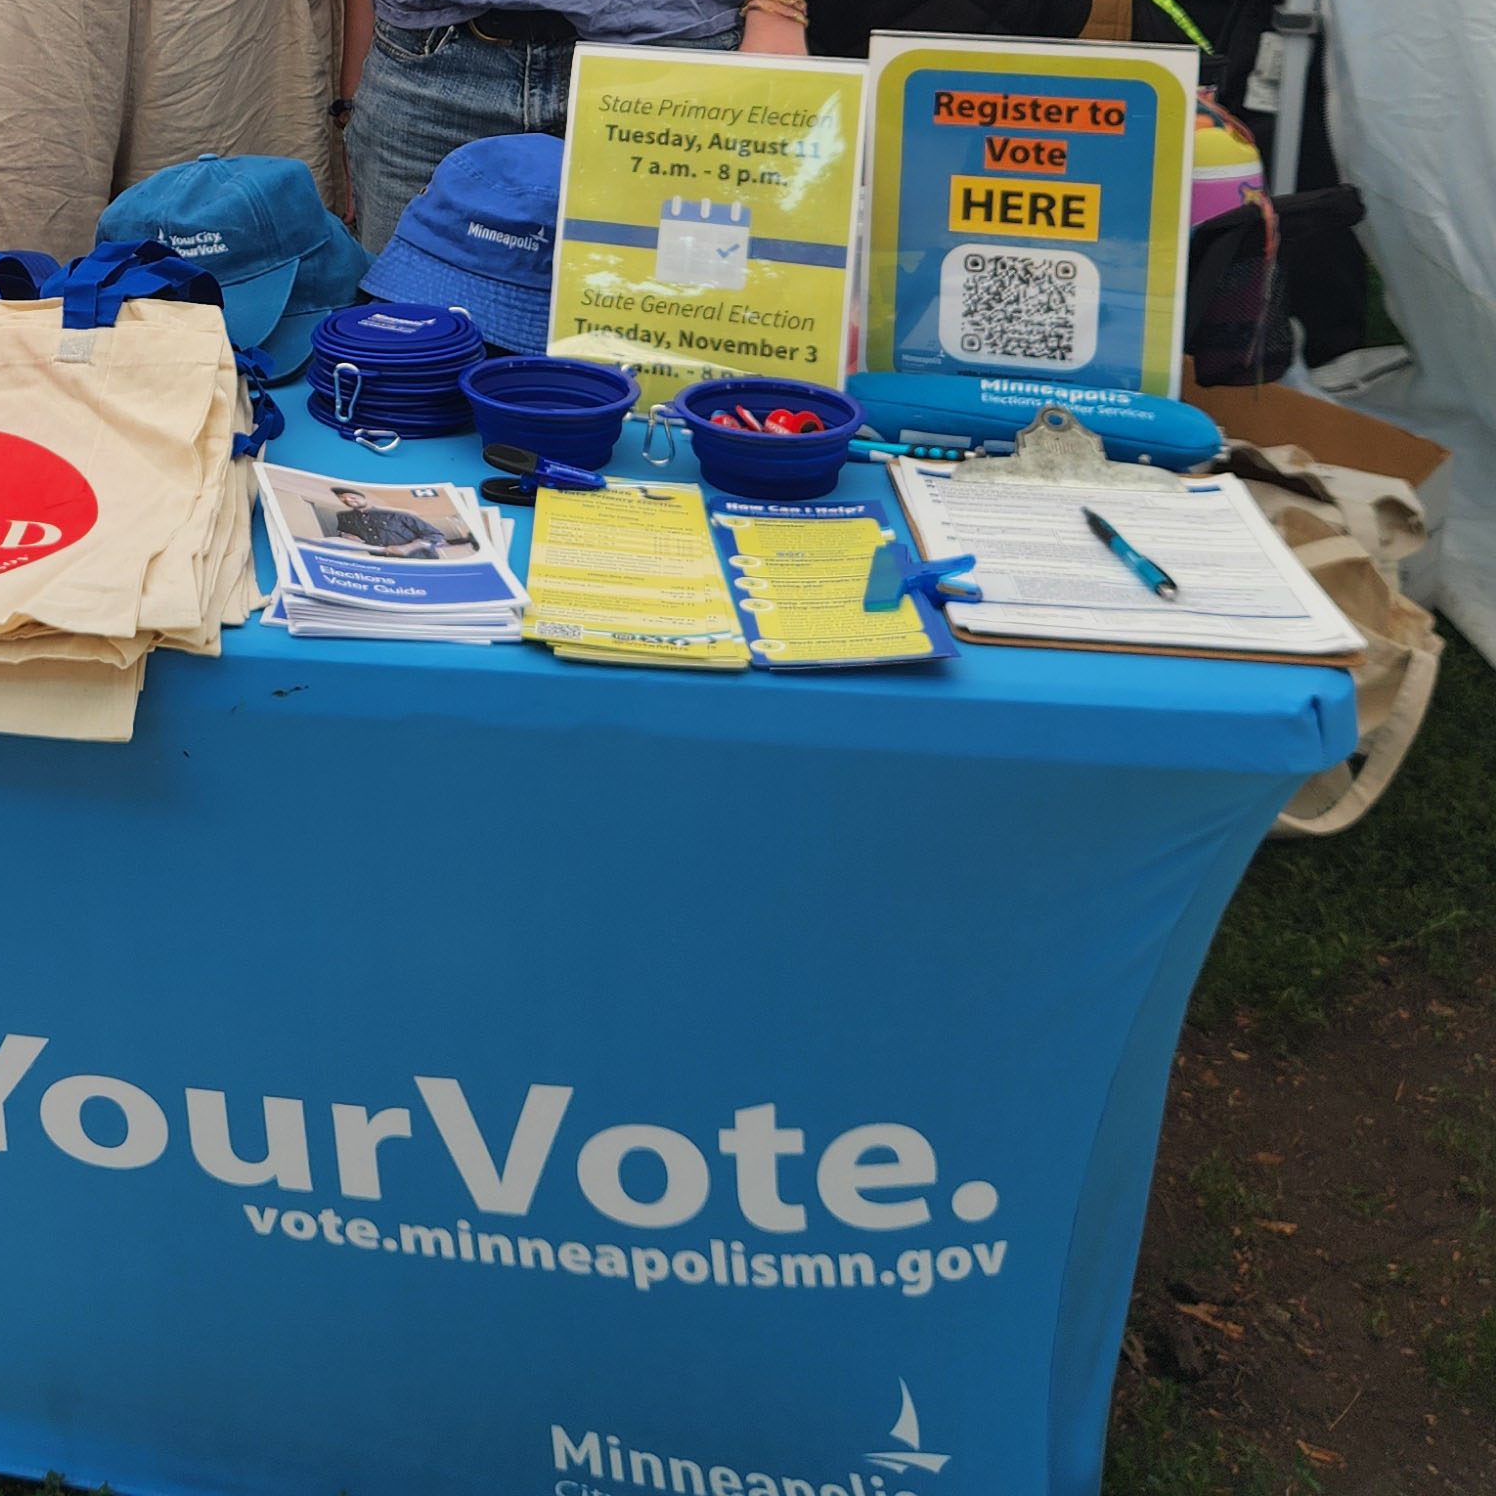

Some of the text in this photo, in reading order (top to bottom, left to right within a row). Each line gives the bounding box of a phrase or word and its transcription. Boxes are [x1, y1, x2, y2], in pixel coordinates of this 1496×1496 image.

[598, 94, 834, 130] State Primary Election
[933, 91, 1126, 128] Register to
[605, 124, 822, 159] Tuesday, August 11
[985, 136, 1068, 168] Vote
[631, 156, 642, 173] 7
[648, 162, 698, 179] a.m.
[718, 164, 731, 181] 8
[736, 168, 789, 188] p.m.
[961, 187, 1087, 229] HERE
[467, 221, 540, 252] Minneapolis
[581, 288, 816, 332] State General Election
[573, 317, 819, 364] Tuesday, November 3
[980, 378, 1132, 405] Minneapolis
[980, 393, 1042, 408] Elections
[1096, 404, 1154, 421] Services
[725, 502, 764, 512] How
[767, 504, 802, 513] Can
[815, 505, 866, 515] Help?
[318, 564, 396, 585] Elections
[322, 574, 427, 597] Voter Guide
[242, 1200, 1009, 1297] vote.minneapolismn.gov
[550, 1423, 916, 1496] Minneapoli
